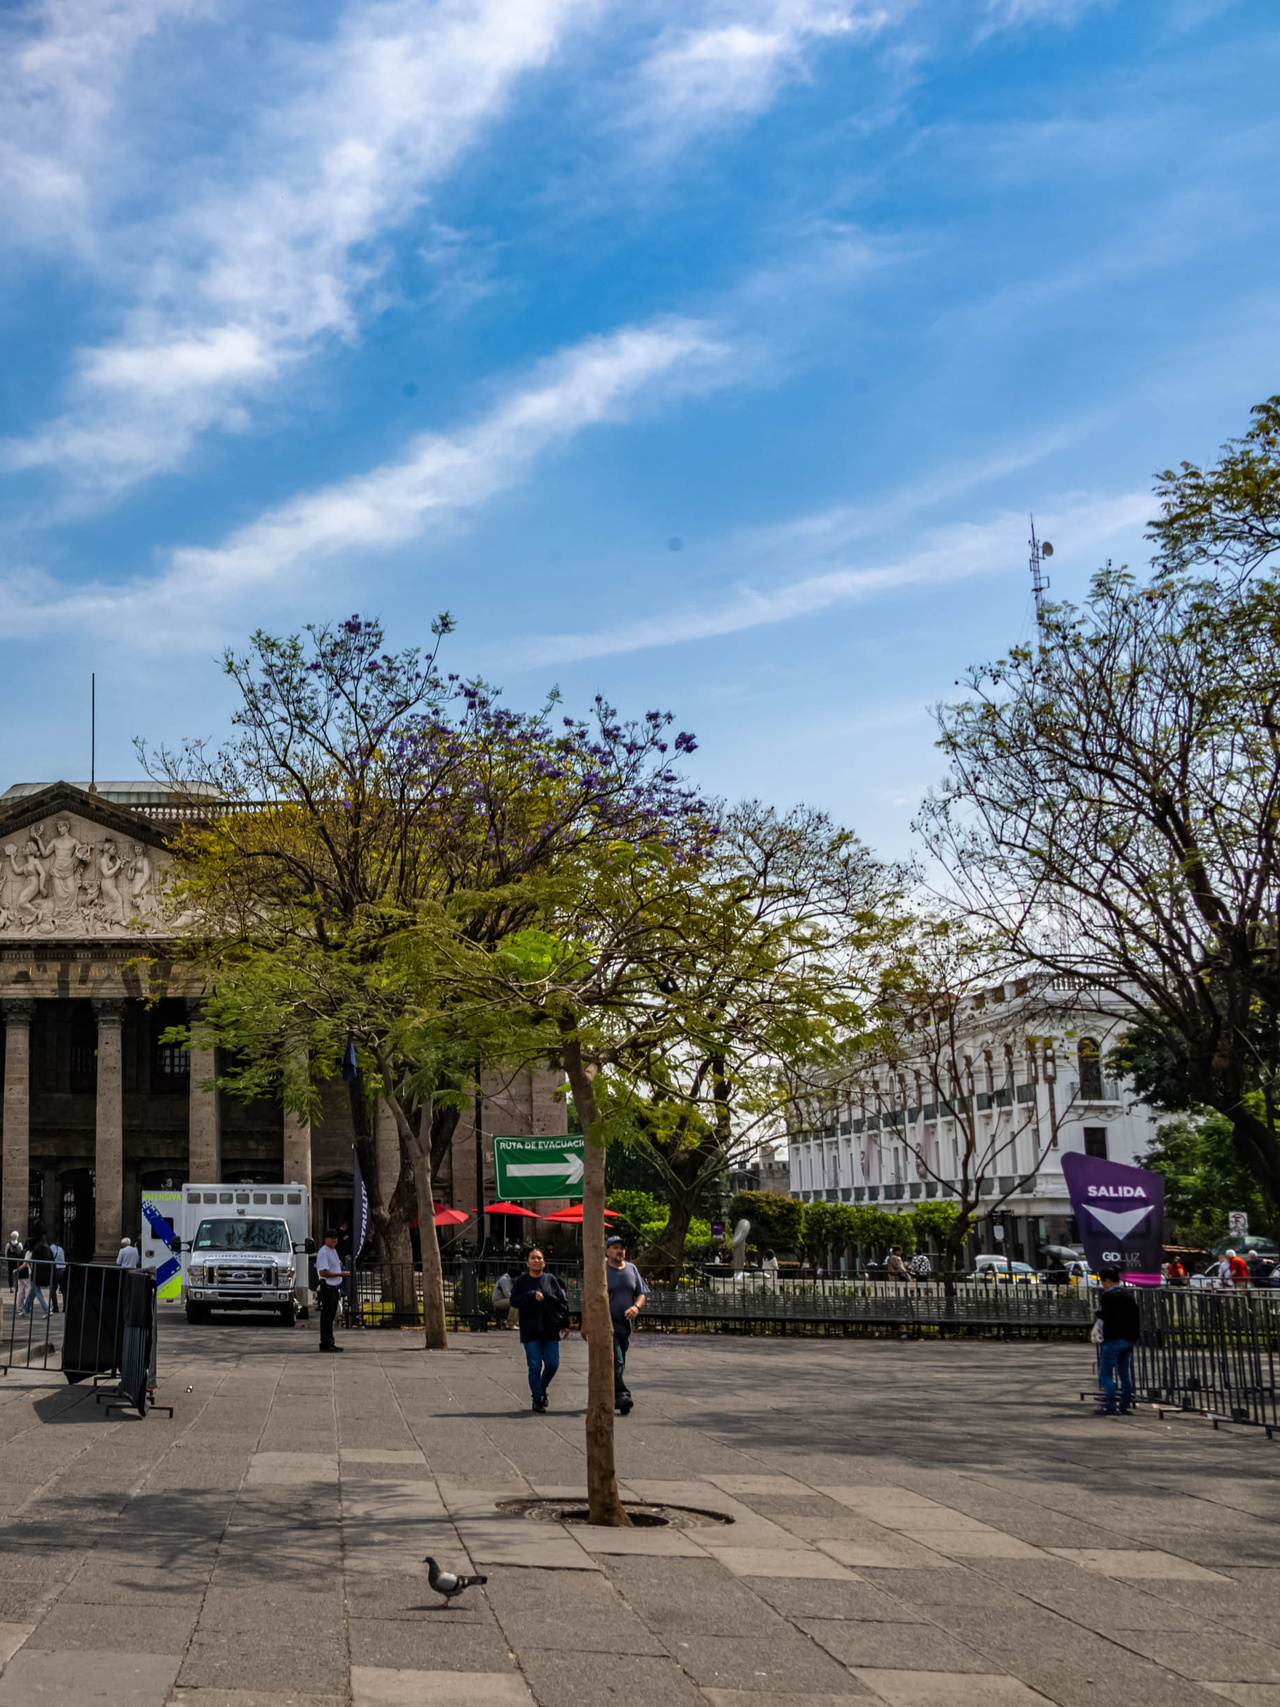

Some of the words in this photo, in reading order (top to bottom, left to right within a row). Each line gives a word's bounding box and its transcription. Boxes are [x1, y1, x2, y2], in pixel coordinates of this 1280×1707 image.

[500, 1141, 523, 1150] RUTA
[525, 1141, 536, 1149] DE
[538, 1140, 584, 1149] EVACUACI
[1087, 1186, 1147, 1197] SALIDA
[142, 1192, 182, 1202] INTENSIVA
[1102, 1251, 1140, 1262] GDLUZ
